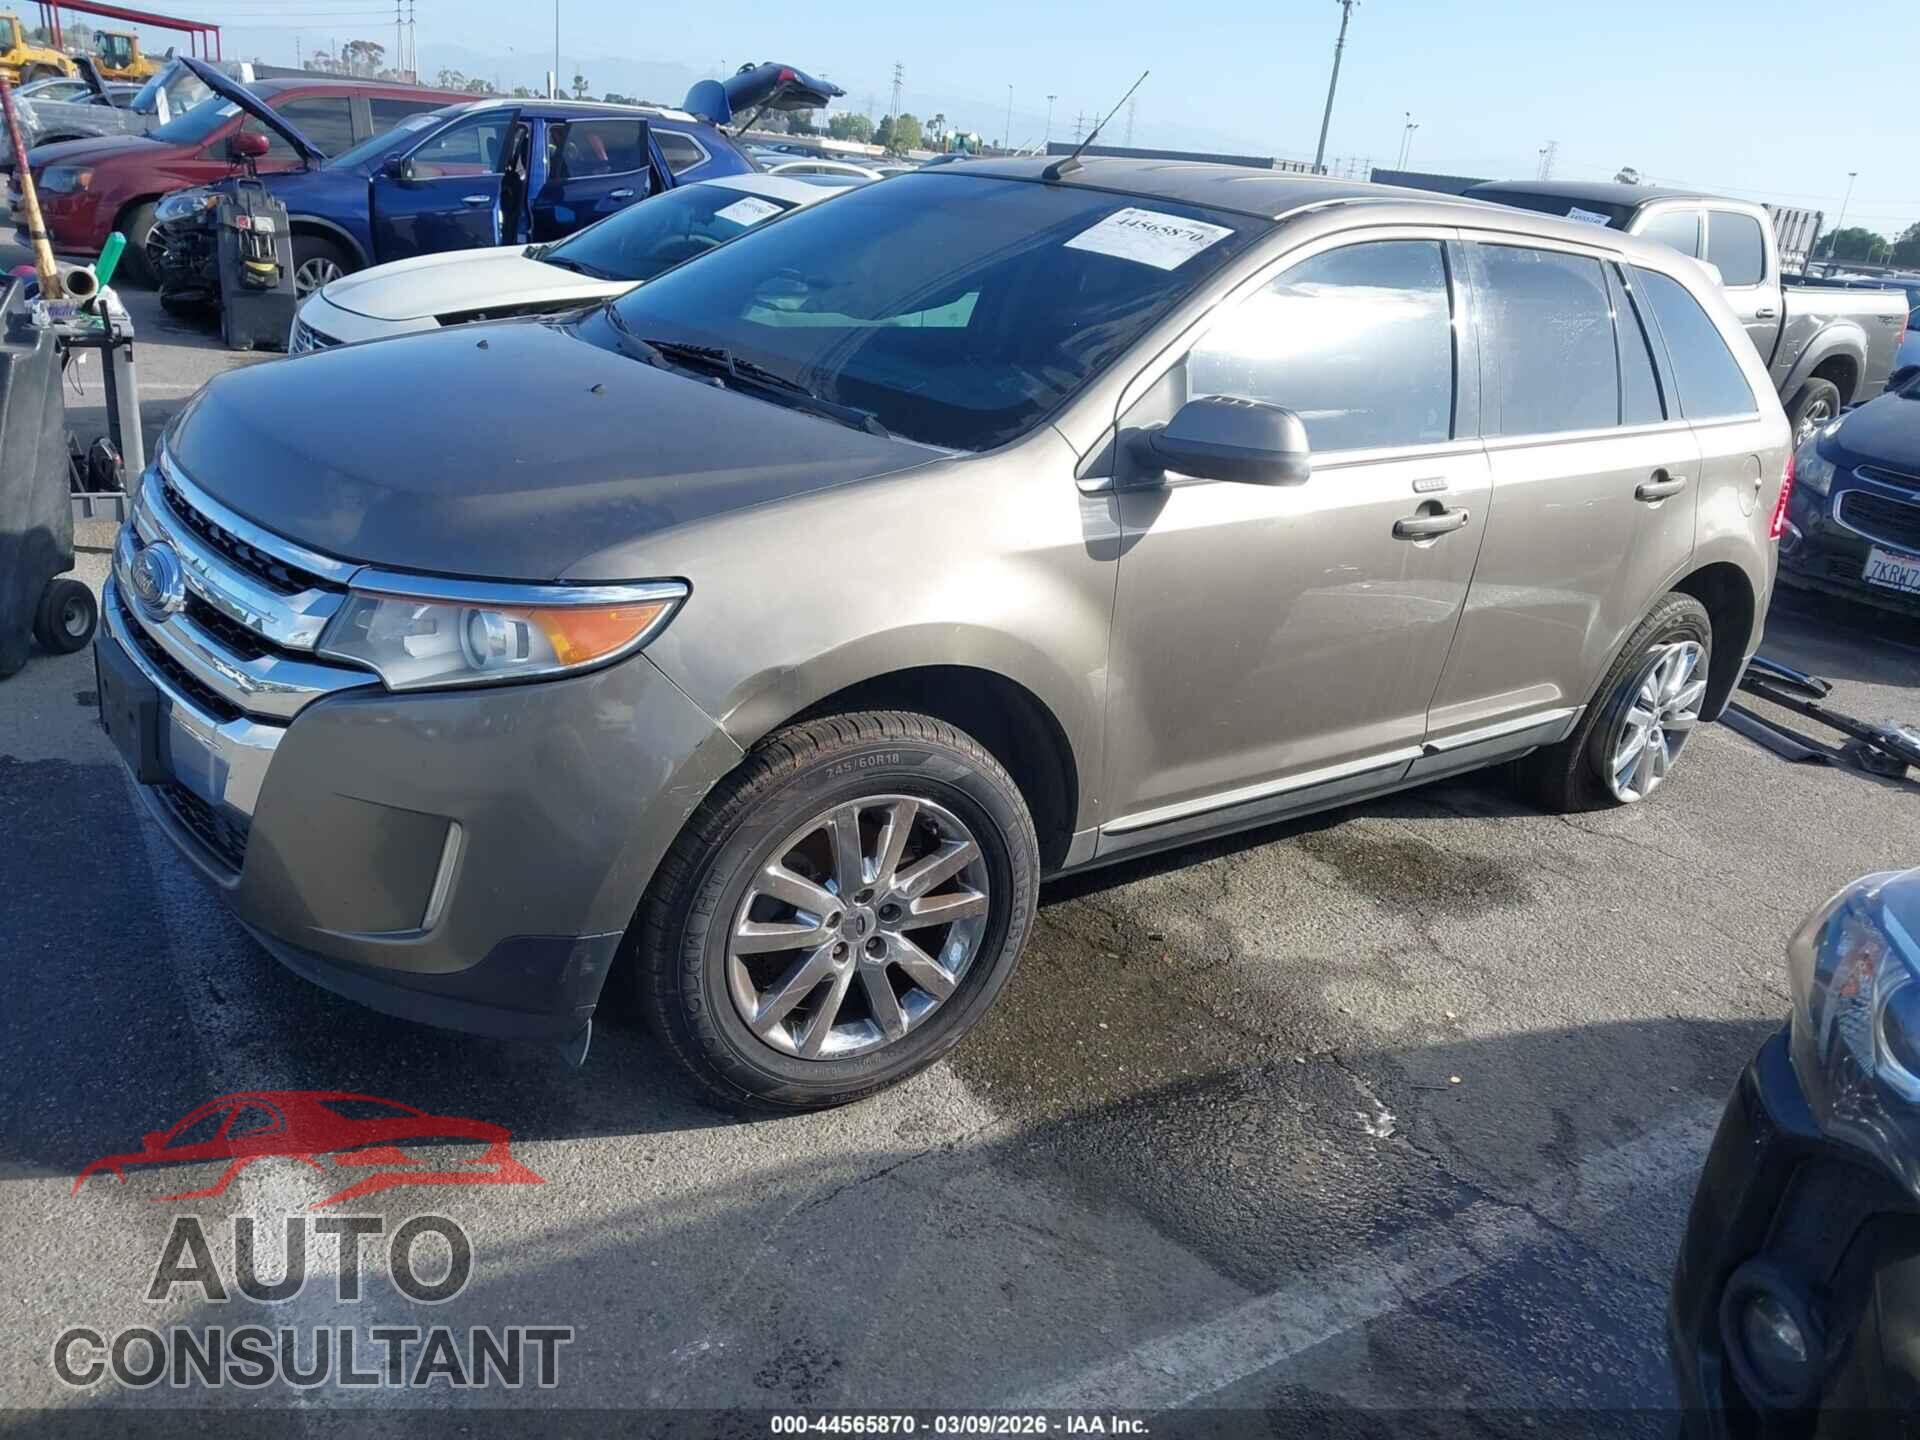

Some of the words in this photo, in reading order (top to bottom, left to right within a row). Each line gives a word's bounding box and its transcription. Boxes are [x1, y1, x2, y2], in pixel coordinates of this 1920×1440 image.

[1116, 217, 1205, 242] 44565870
[1871, 559, 1920, 587] 7KRW7
[825, 752, 901, 779] 245/60R18
